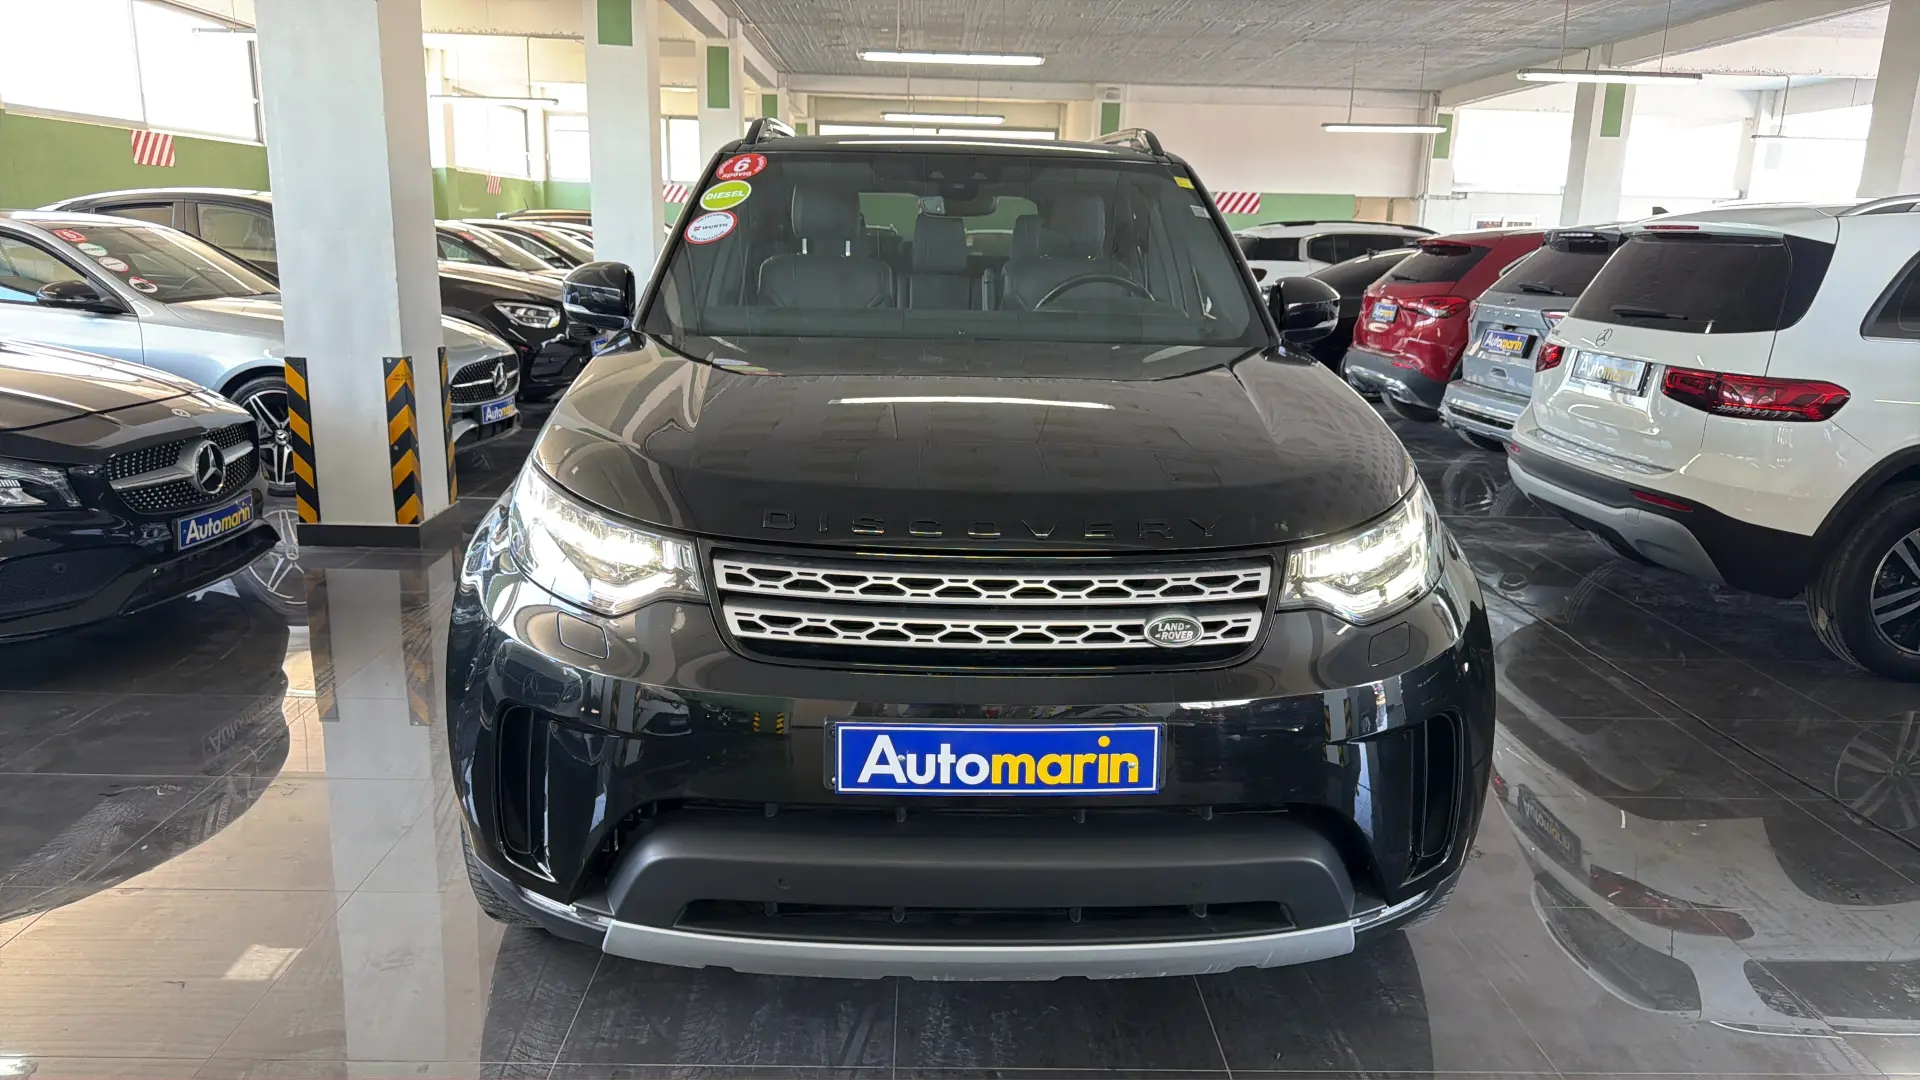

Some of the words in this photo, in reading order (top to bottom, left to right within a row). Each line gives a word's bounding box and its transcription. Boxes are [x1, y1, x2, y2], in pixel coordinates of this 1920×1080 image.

[734, 159, 751, 172] 6
[705, 190, 745, 200] DIESEL
[1484, 332, 1523, 352] Automarin
[185, 502, 251, 544] Automarin
[762, 507, 1223, 541] DISCOVERY
[1158, 622, 1184, 632] LAND
[1161, 631, 1194, 641] ROVER
[857, 734, 1139, 785] Automarin
